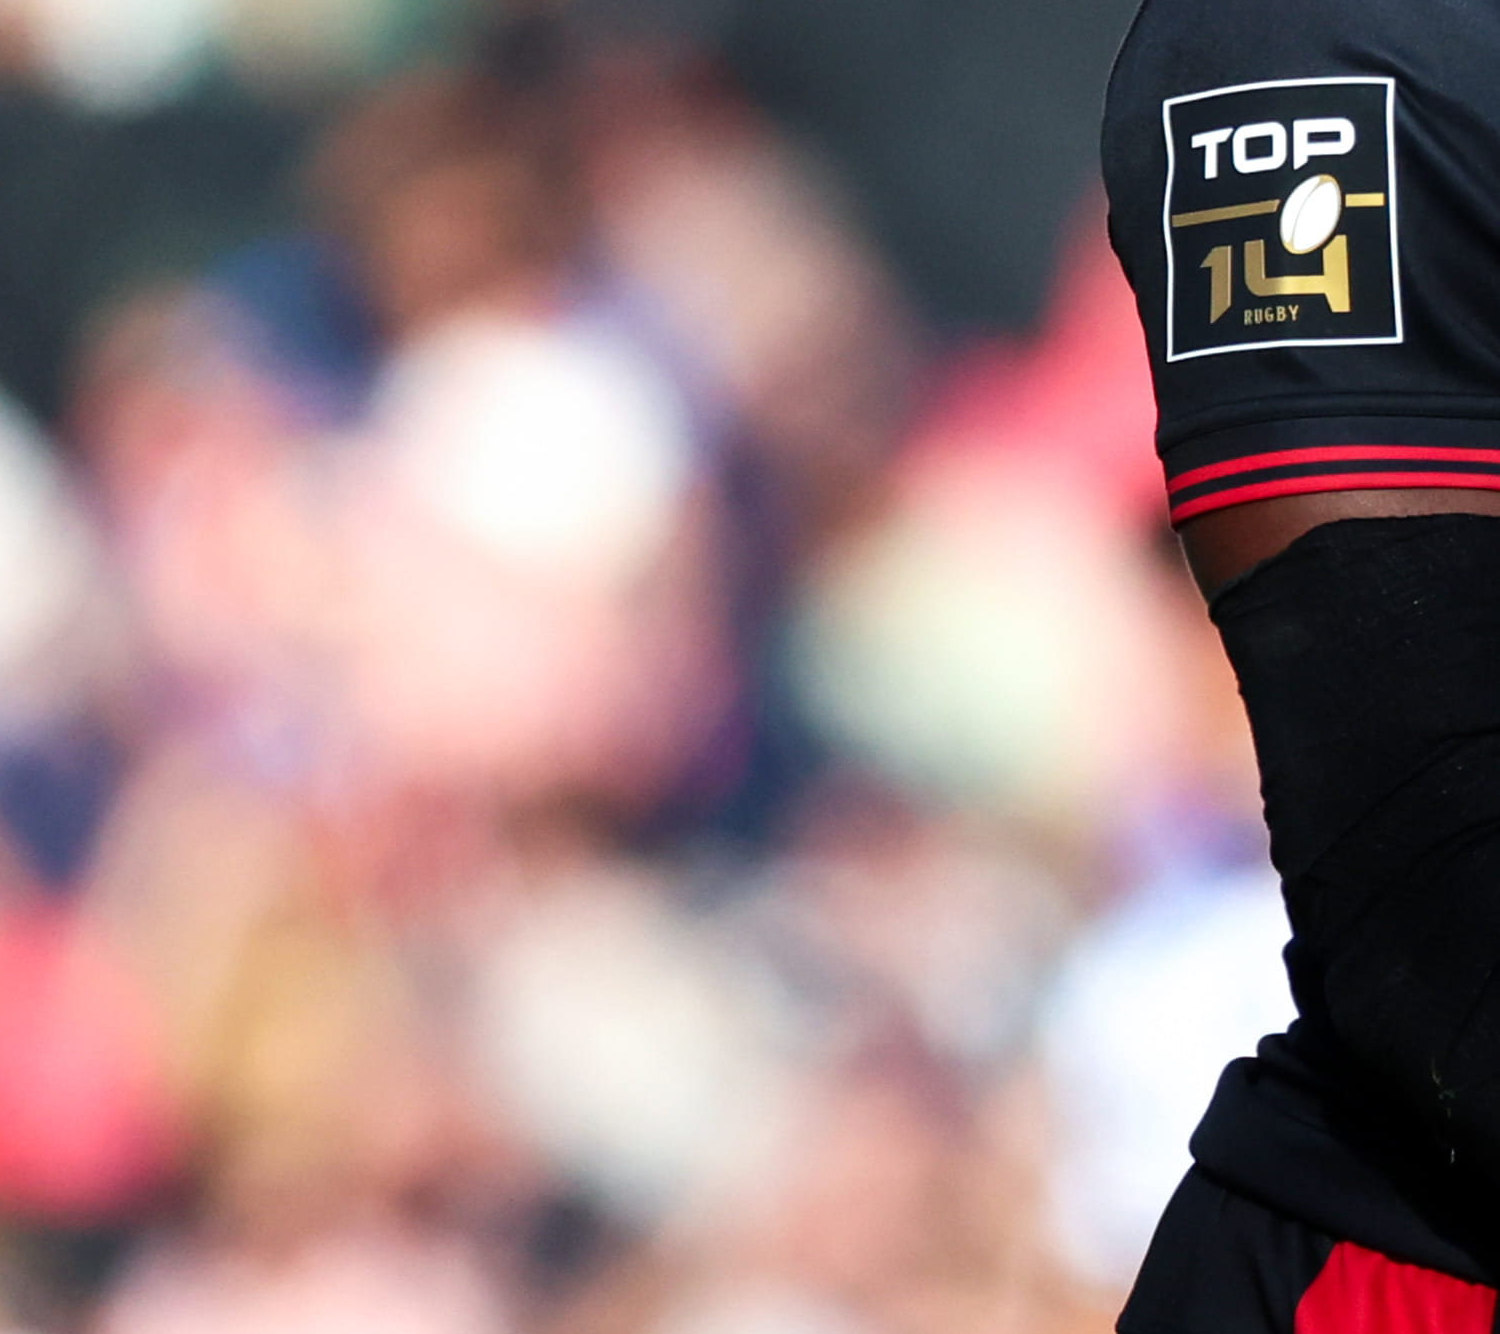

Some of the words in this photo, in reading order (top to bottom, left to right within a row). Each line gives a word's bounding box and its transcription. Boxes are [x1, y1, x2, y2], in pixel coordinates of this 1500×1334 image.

[1191, 117, 1356, 180] TOP
[1200, 234, 1351, 324] 14
[1244, 304, 1300, 327] RUGBY
